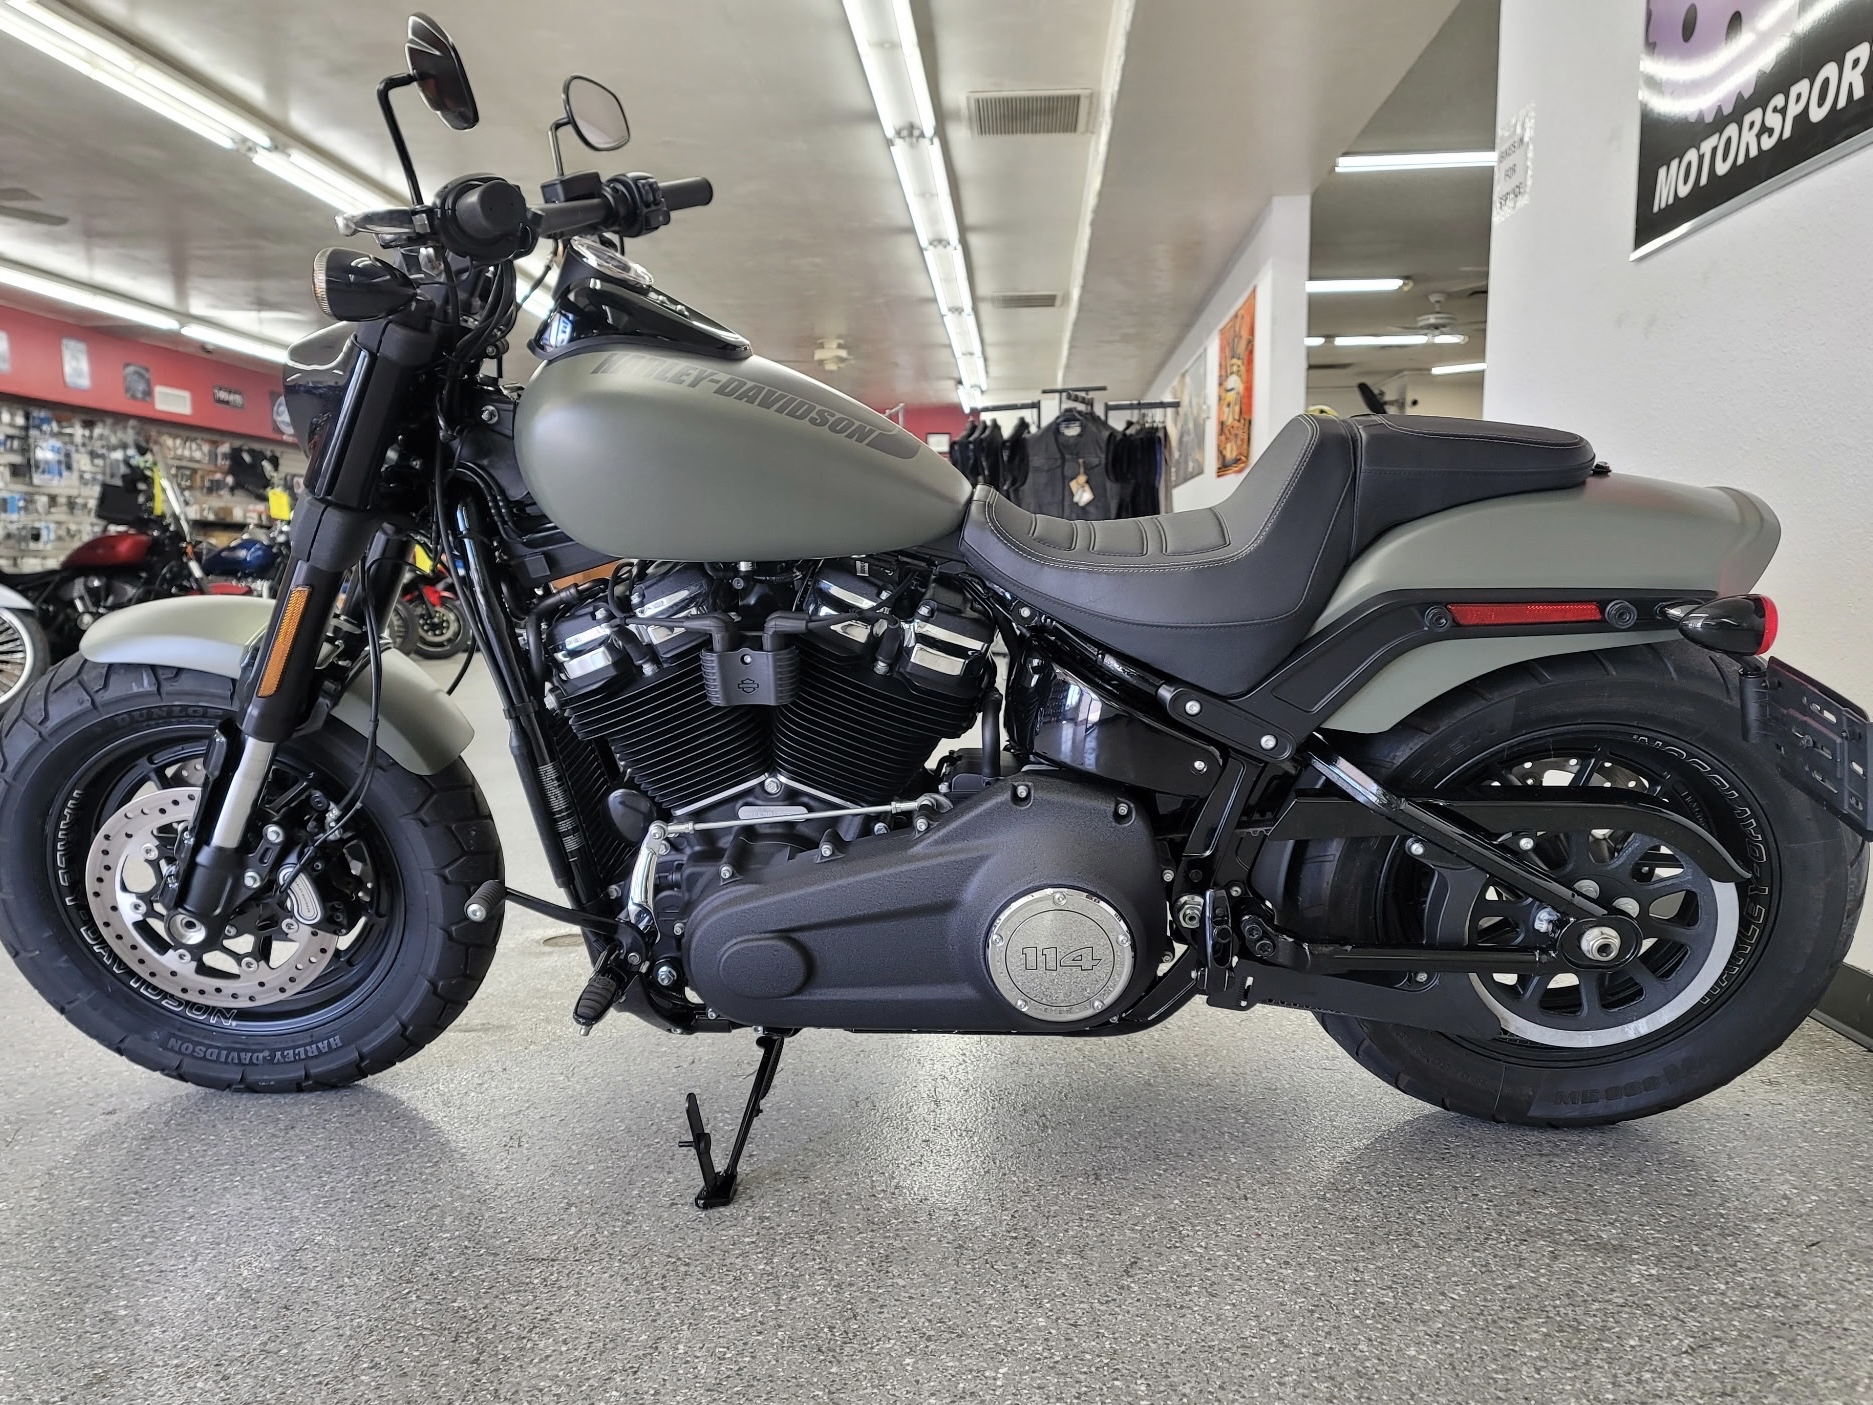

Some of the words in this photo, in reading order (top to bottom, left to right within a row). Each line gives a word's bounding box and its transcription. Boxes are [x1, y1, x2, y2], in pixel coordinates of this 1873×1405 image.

[1653, 41, 1873, 214] MOTORSPOR
[589, 352, 876, 446] HARLEY-DAVIDSON
[1021, 946, 1102, 971] 114
[167, 1034, 343, 1066] HARLEY-DAVIDSON
